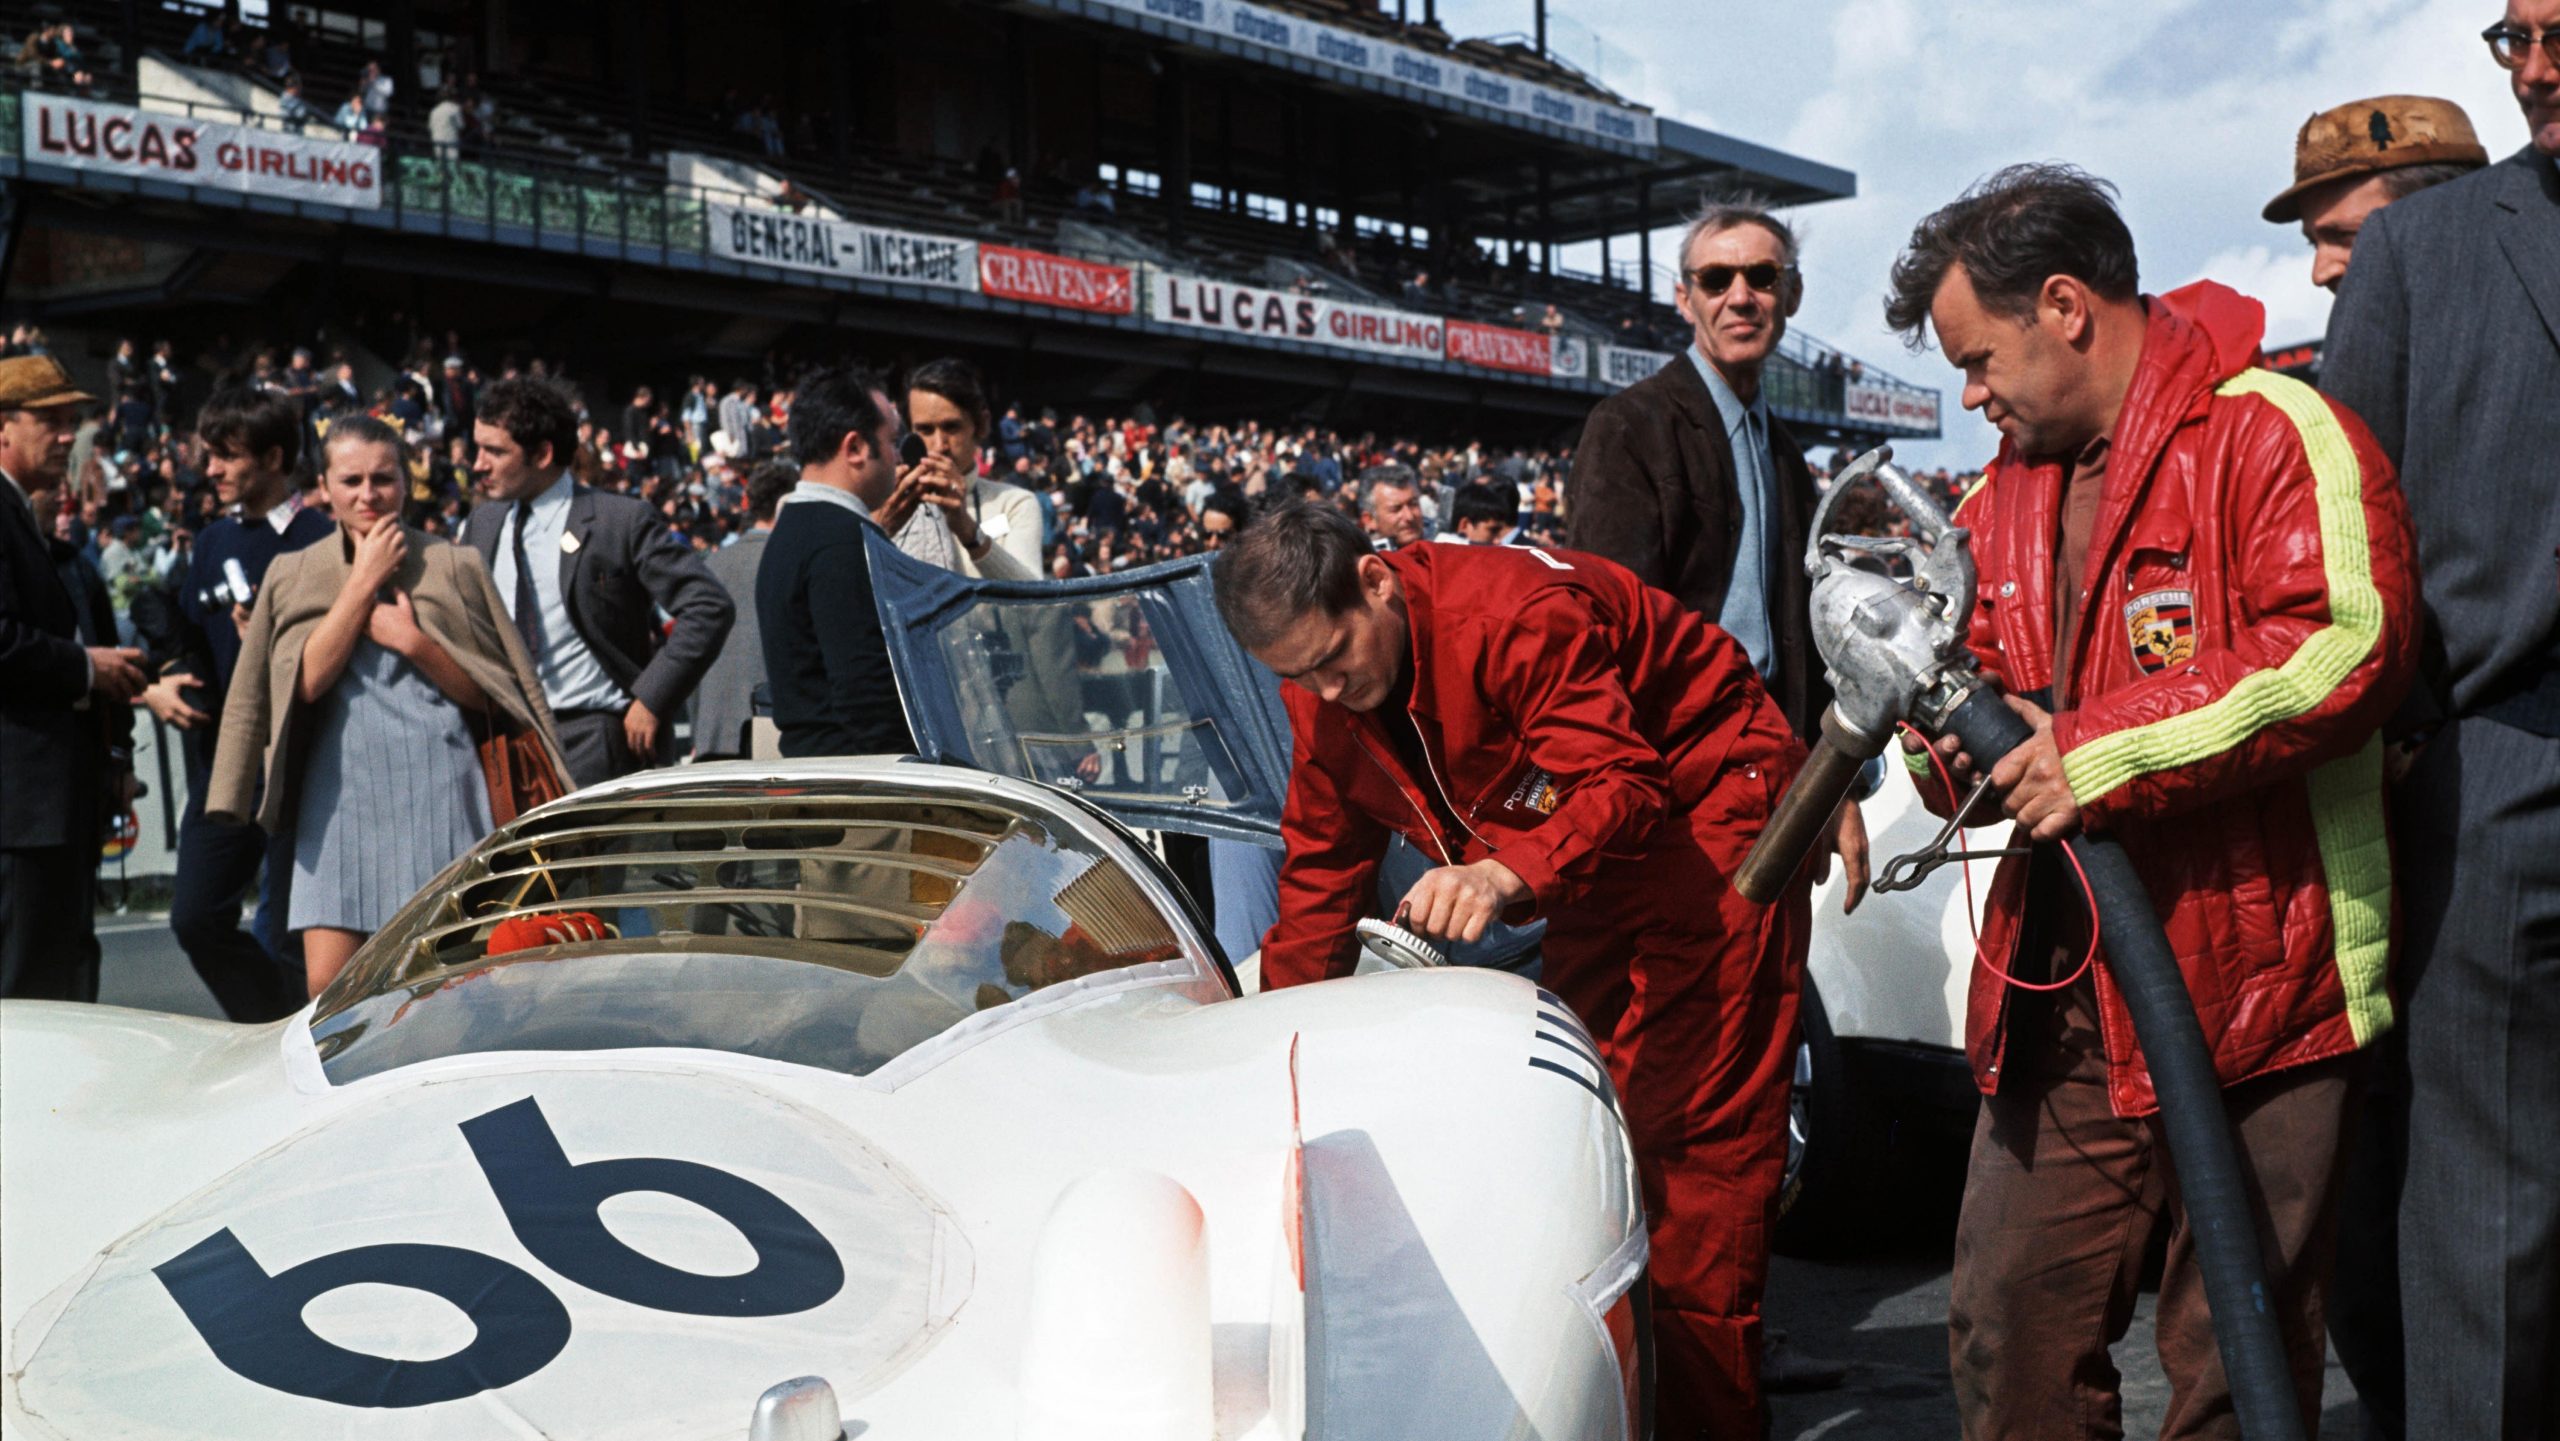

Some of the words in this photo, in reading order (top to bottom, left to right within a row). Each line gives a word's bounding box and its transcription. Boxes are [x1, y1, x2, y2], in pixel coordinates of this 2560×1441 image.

[39, 106, 197, 171] LUCAS
[216, 142, 373, 190] GIRLING
[1169, 278, 1317, 337] LUCAS
[1329, 310, 1441, 351] GIRLING
[2126, 592, 2190, 616] PORSCHE
[151, 1095, 845, 1409] 66
